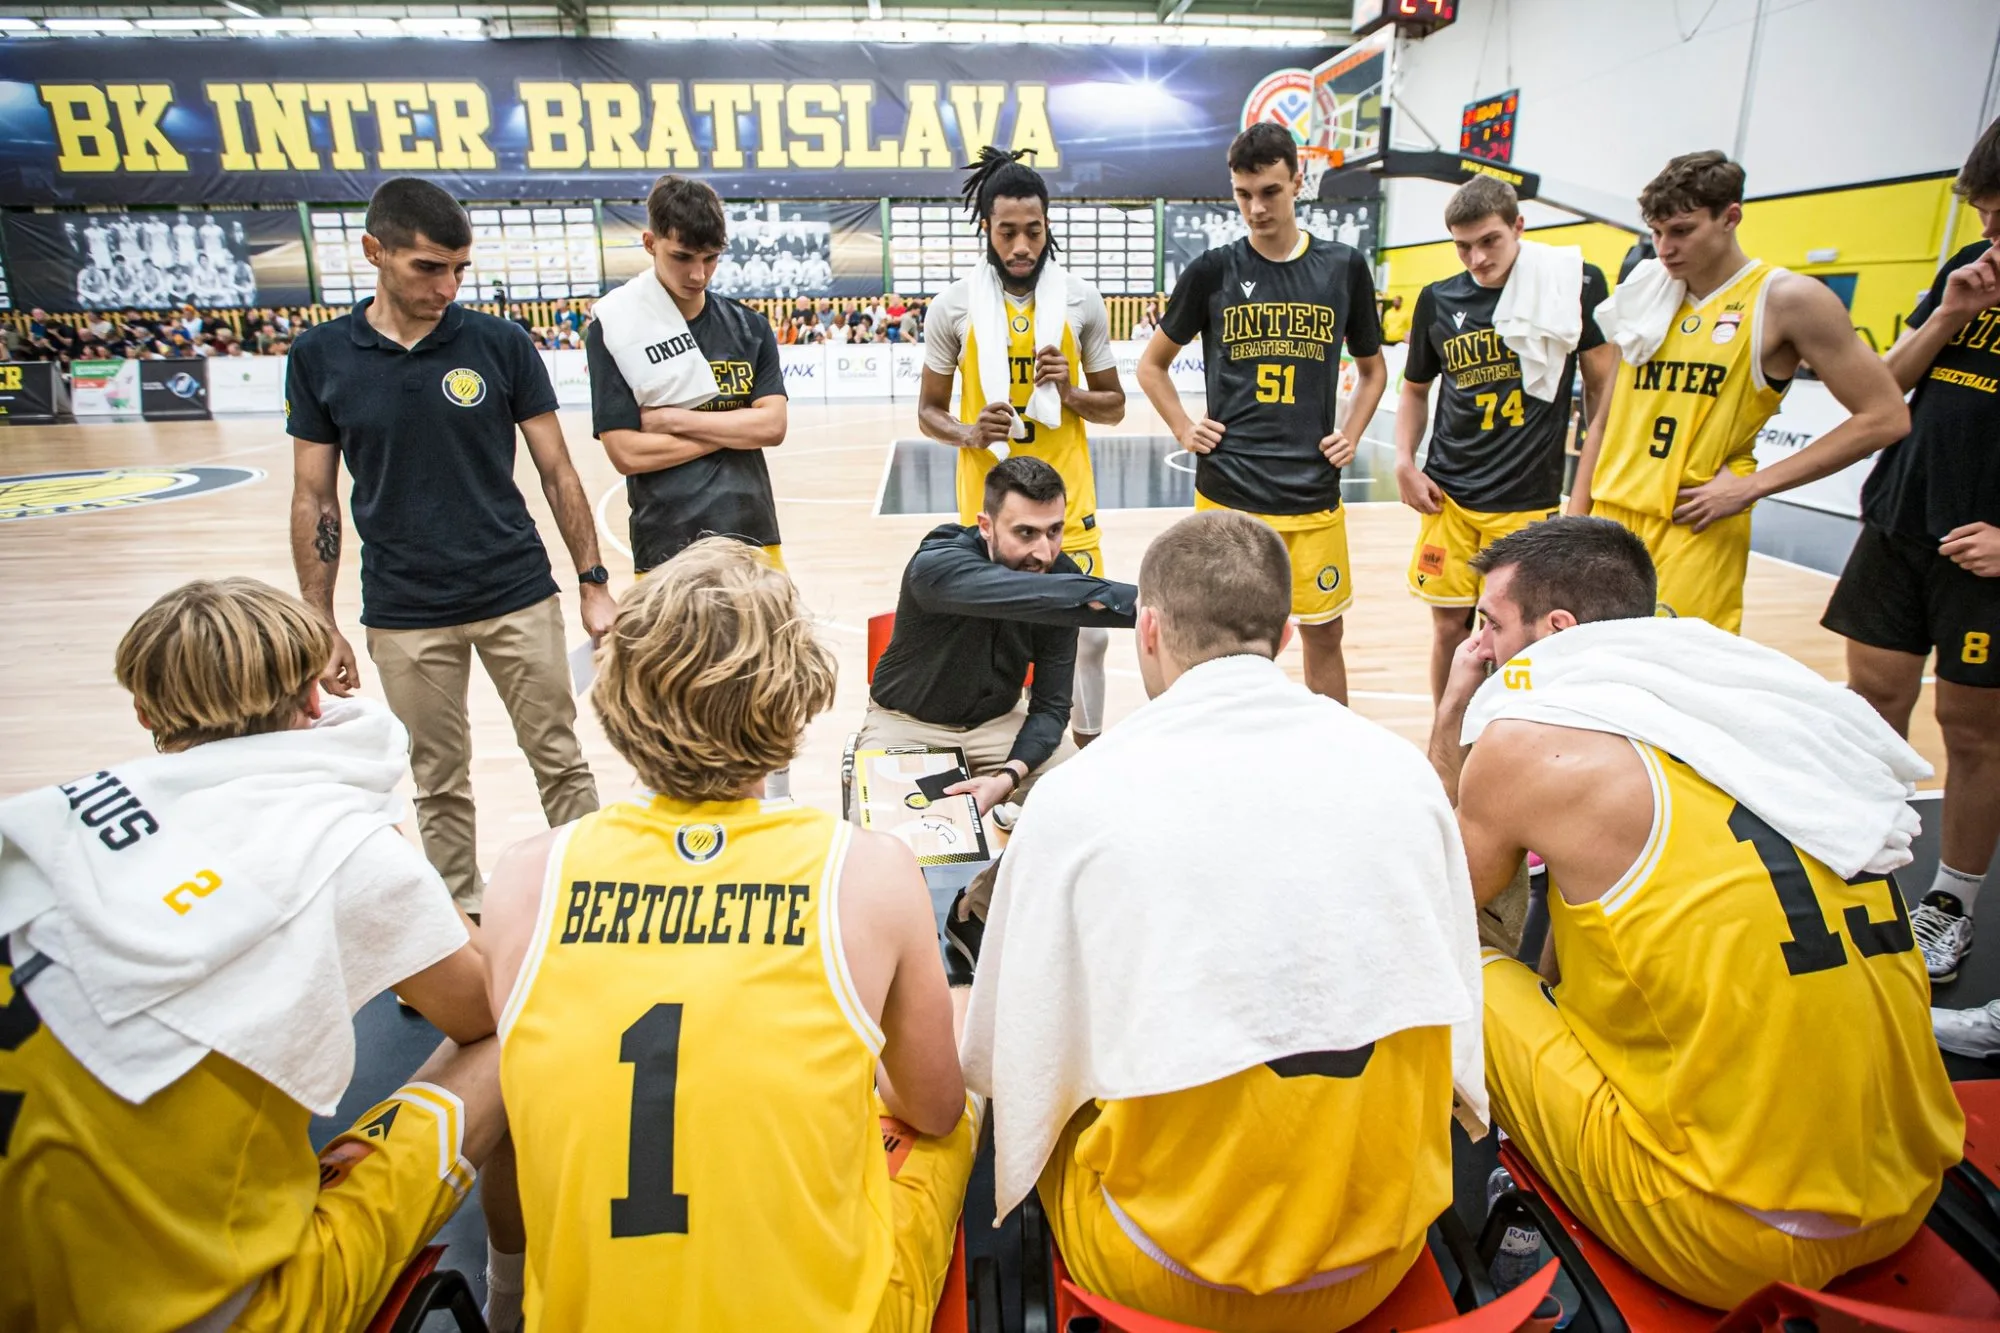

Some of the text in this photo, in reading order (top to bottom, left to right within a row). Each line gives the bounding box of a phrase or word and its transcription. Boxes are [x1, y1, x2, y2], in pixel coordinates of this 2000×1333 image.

[40, 81, 1061, 172] BK INTER BRATISLAVA
[1223, 303, 1335, 343] INTER
[1231, 340, 1325, 361] BRATISLAVA
[1443, 328, 1519, 372] INT
[1256, 364, 1295, 404] 51
[1633, 360, 1727, 398] INTER
[1475, 389, 1524, 430] 74
[1649, 416, 1678, 460] 9
[1961, 631, 1990, 664] 8
[1504, 657, 1533, 691] 15
[162, 868, 223, 916] 2
[560, 881, 811, 946] BERTOLETTE
[610, 1002, 689, 1239] 1
